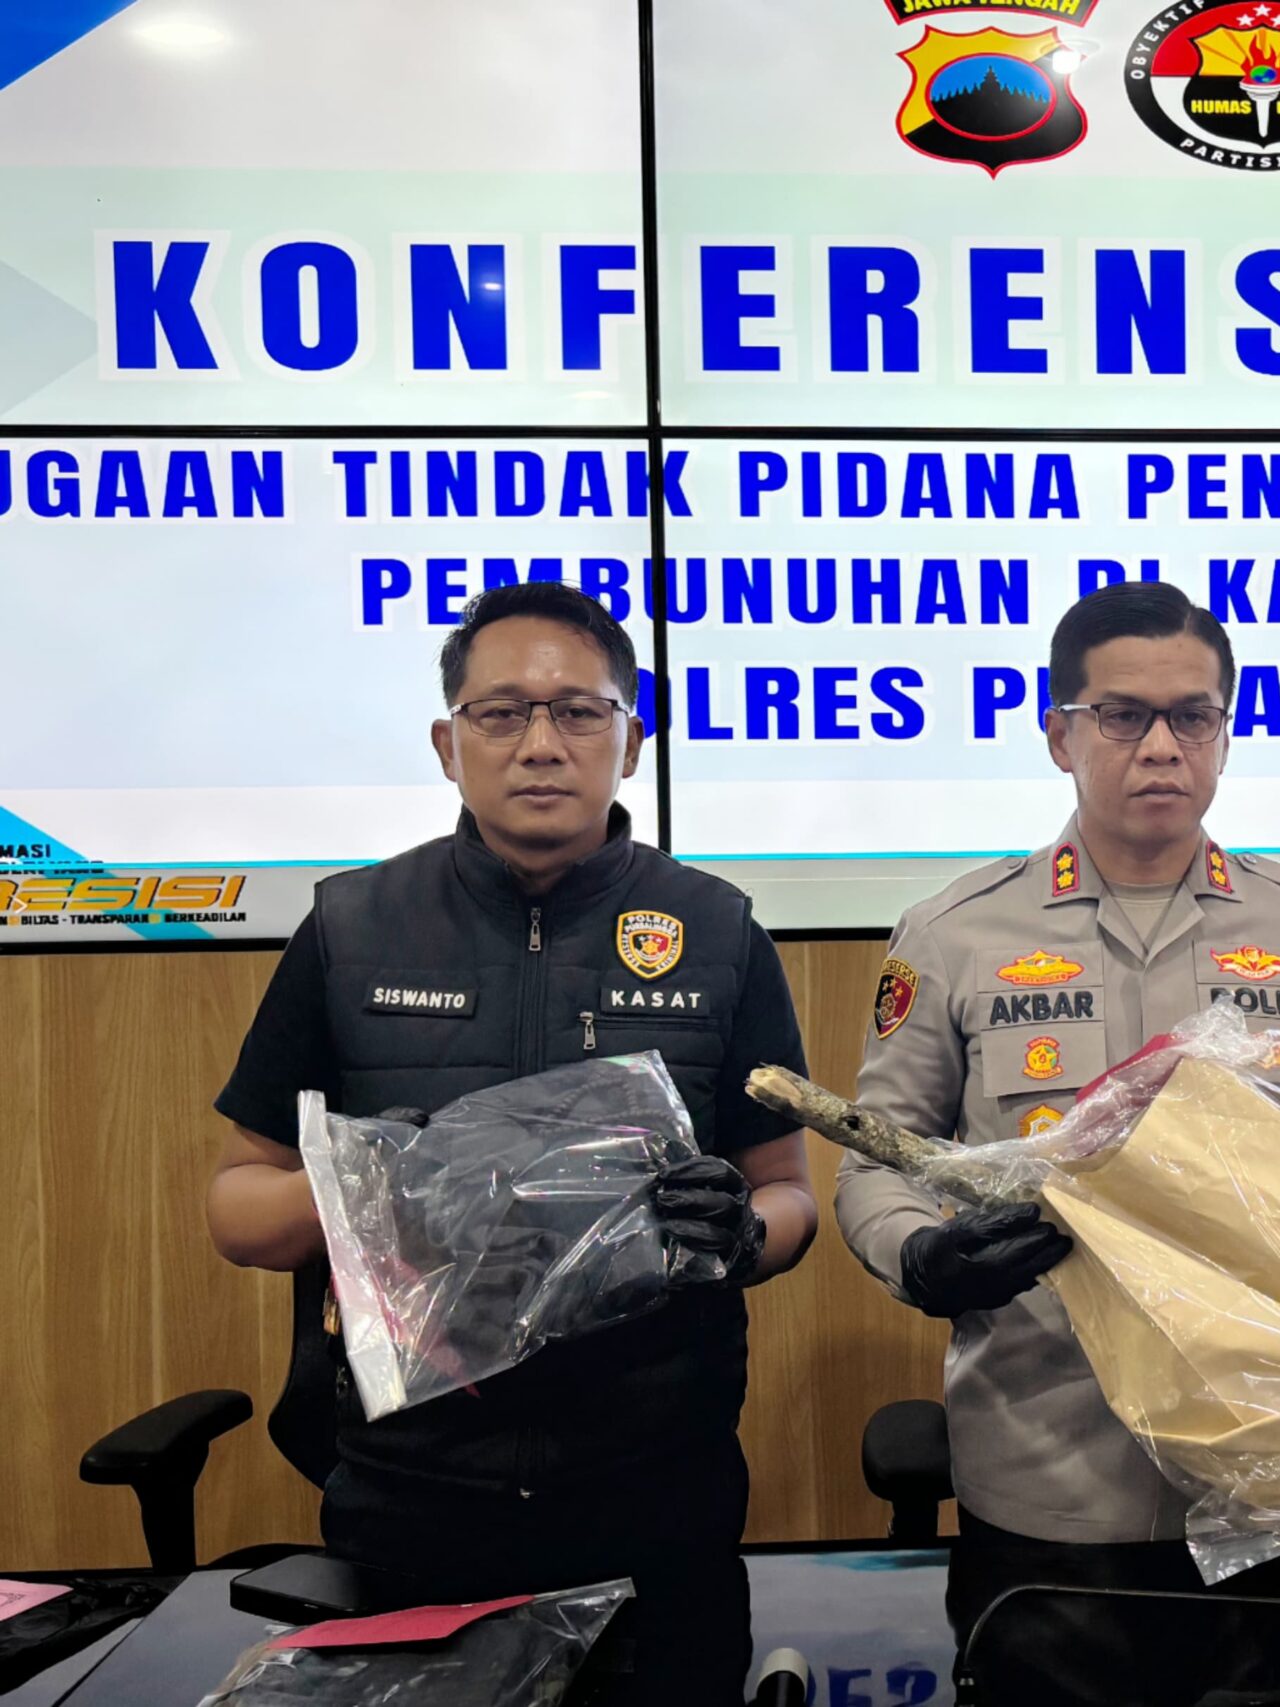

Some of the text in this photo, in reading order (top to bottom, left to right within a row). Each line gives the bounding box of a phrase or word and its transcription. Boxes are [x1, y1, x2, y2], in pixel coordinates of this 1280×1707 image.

[1190, 100, 1252, 114] HUMAS
[332, 450, 693, 518] TINDAK
[738, 450, 1081, 519] PIDANA
[373, 987, 467, 1009] SISWANTO
[611, 990, 702, 1009] KASAT
[989, 990, 1094, 1026] AKBAR
